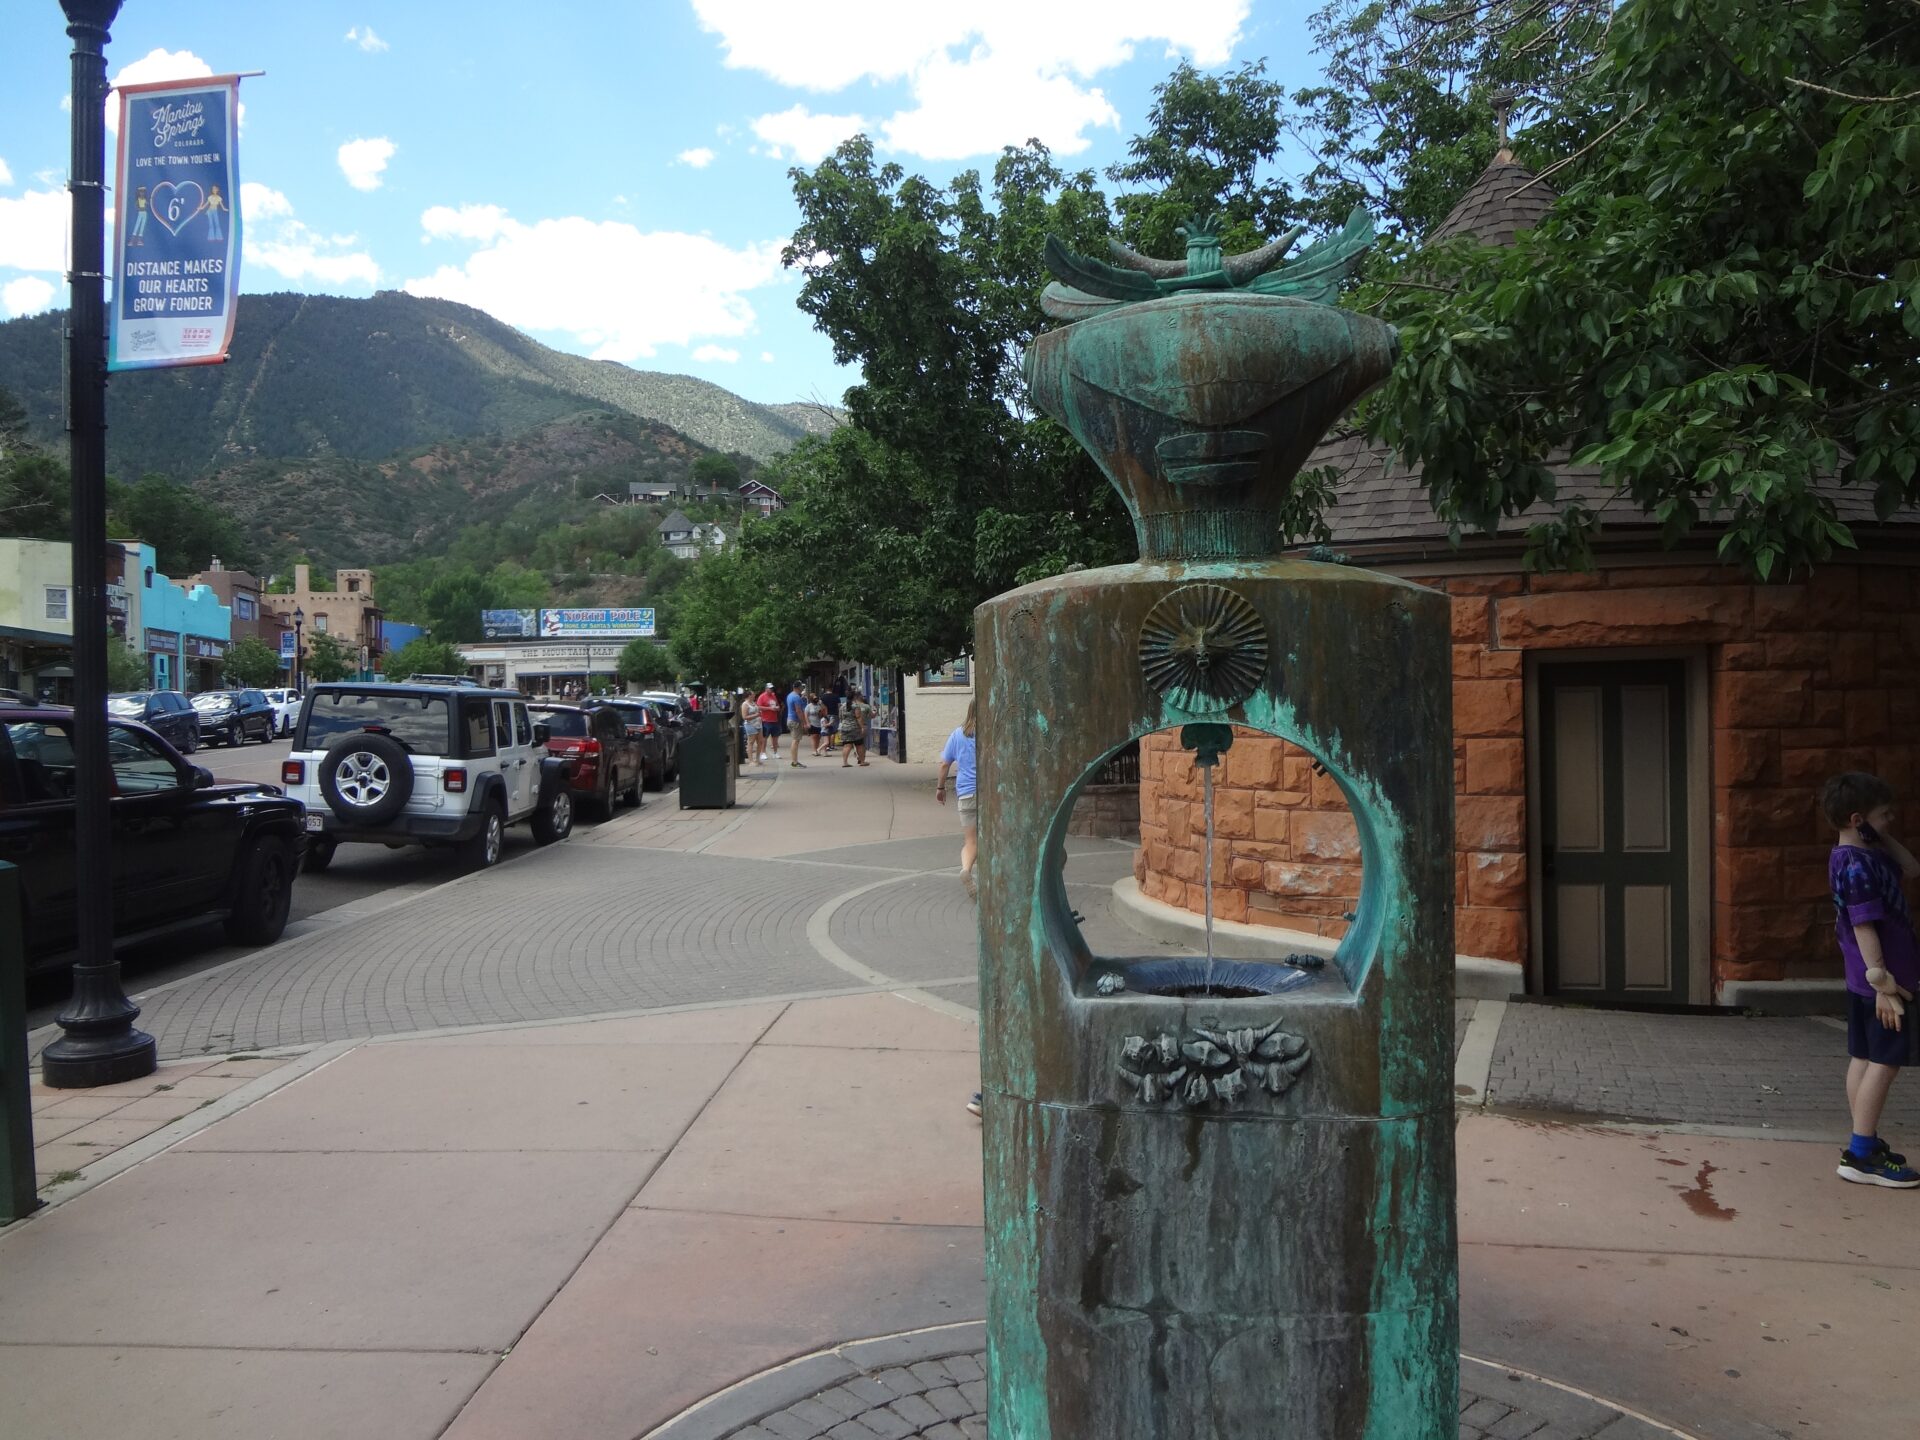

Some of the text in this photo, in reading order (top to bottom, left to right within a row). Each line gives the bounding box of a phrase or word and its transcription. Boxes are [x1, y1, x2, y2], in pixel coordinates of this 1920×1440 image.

[150, 100, 204, 131] Manitou
[153, 115, 206, 148] Springs
[174, 139, 204, 148] COLORADO
[136, 158, 152, 168] LOVE
[154, 156, 165, 166] THE
[167, 156, 189, 165] TOWN
[212, 153, 220, 162] IN
[127, 259, 223, 276] DISTANCE MAKES
[138, 278, 208, 294] OUR HEARTS
[133, 296, 213, 312] GROW FONDER
[563, 611, 606, 622] NORTH
[609, 611, 641, 622] POLE
[542, 648, 589, 657] MOUNTAIN
[593, 648, 614, 656] MAN
